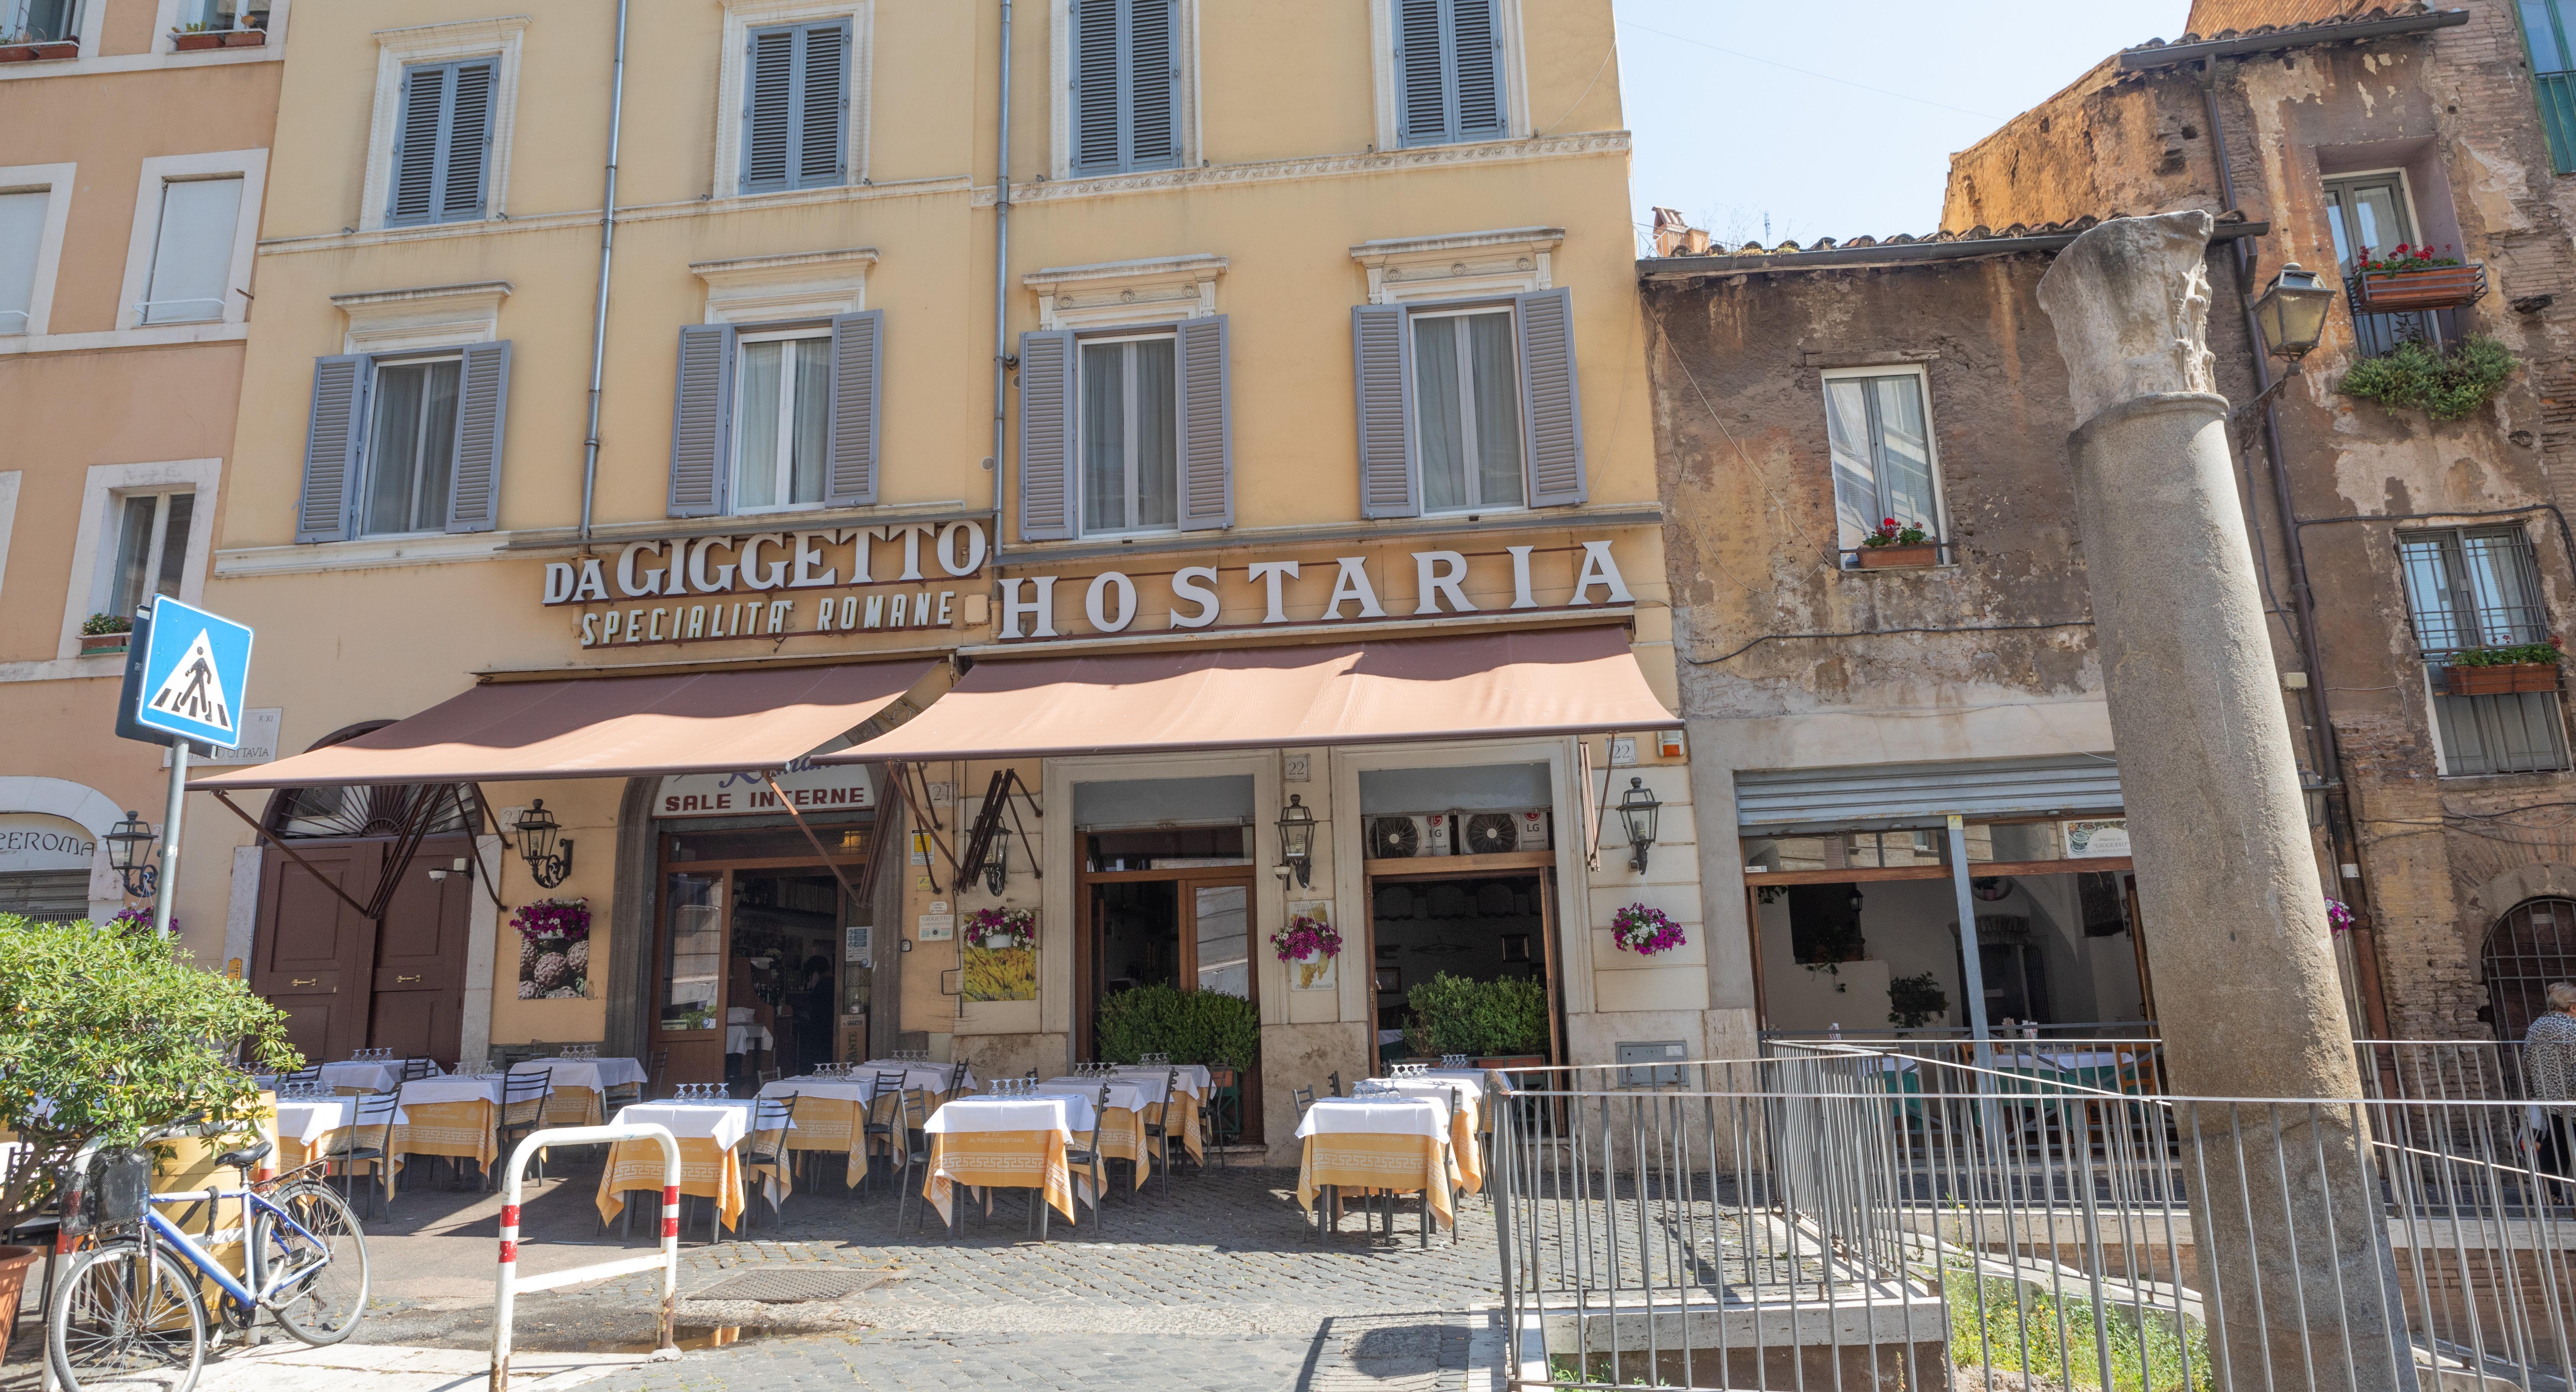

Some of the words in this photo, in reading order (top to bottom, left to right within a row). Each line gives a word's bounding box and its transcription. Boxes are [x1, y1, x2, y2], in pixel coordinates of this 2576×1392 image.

[542, 559, 610, 605] DA
[617, 520, 987, 597] GIGGETTO
[998, 540, 1635, 639] HOSTARIA
[817, 591, 955, 631] ROMANE
[1289, 762, 1304, 775] 22
[665, 793, 731, 812] SALE
[750, 788, 864, 808] INTERNE
[933, 785, 950, 801] 21
[1526, 824, 1540, 832] LG
